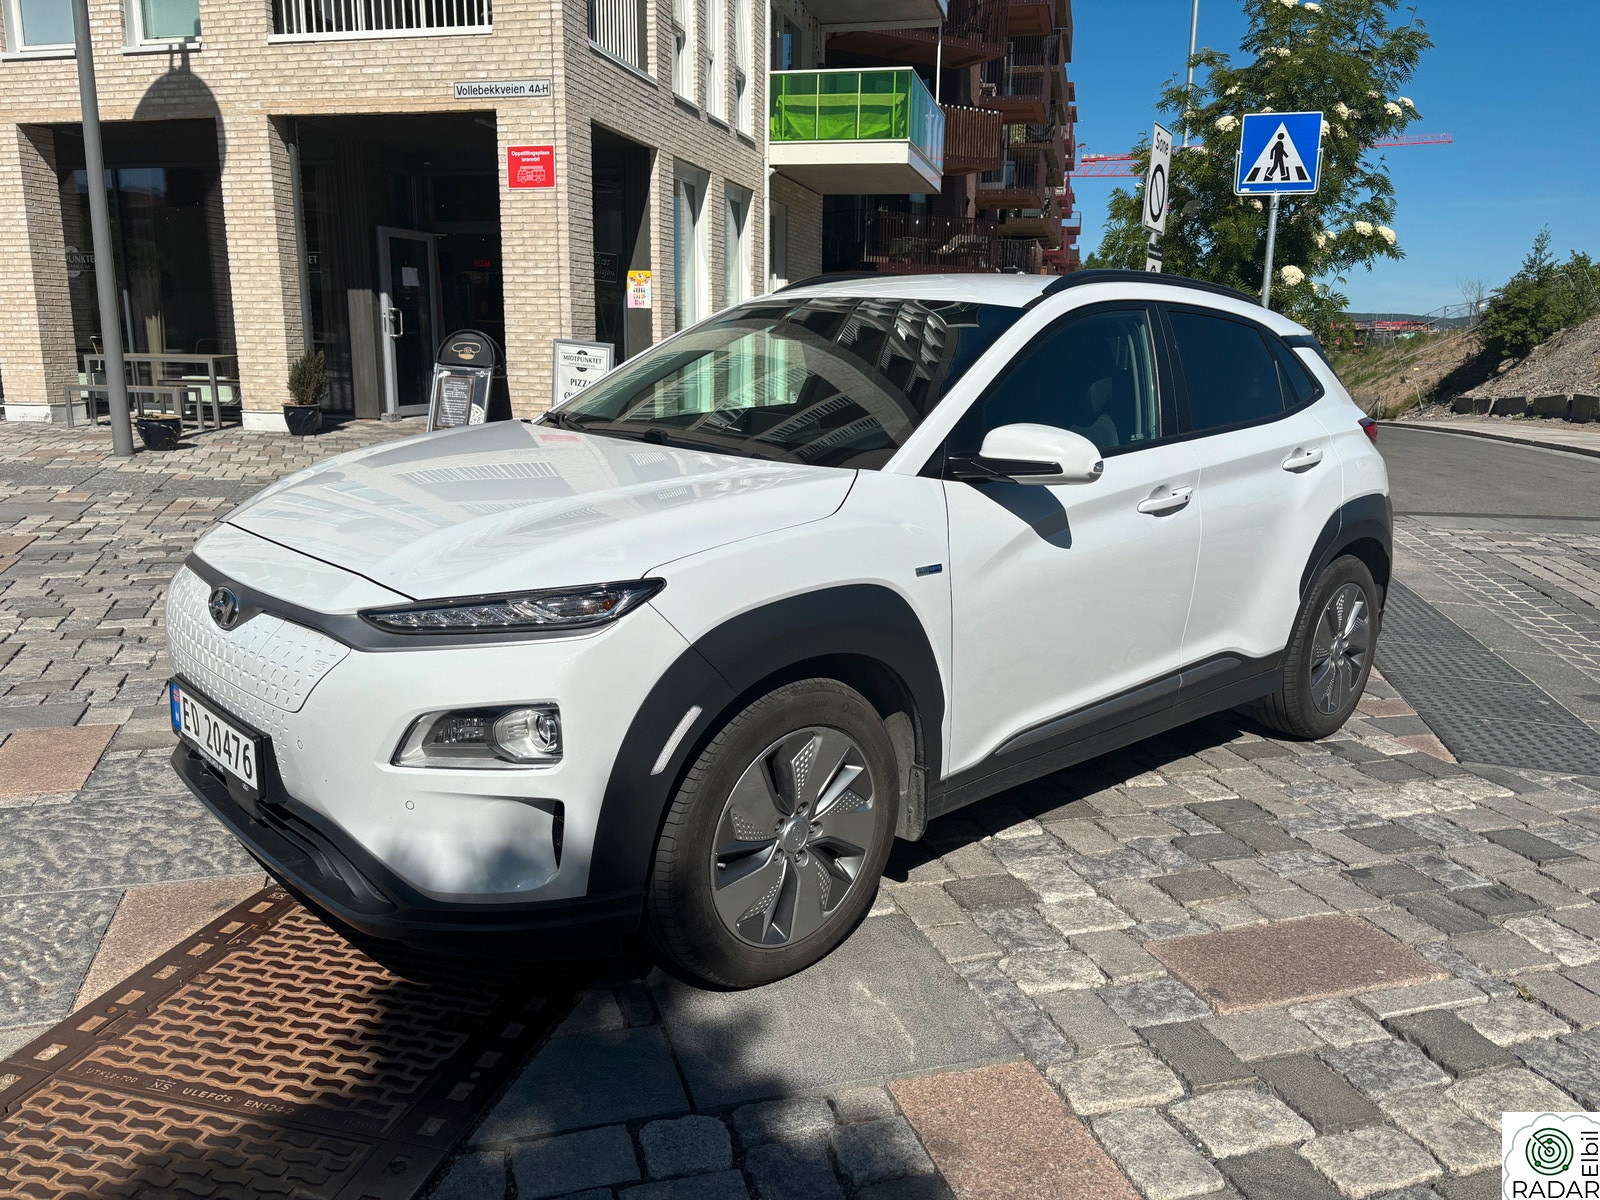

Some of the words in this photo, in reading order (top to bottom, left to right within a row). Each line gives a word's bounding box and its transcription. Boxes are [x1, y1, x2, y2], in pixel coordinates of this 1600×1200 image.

[456, 84, 525, 95] Vollebekkveien
[528, 84, 549, 93] 4A-H
[1156, 132, 1169, 155] Sone
[563, 355, 602, 365] MIDTPUNKTET
[182, 696, 200, 738] ED
[204, 713, 253, 780] 20476
[243, 1099, 295, 1115] EN124-2
